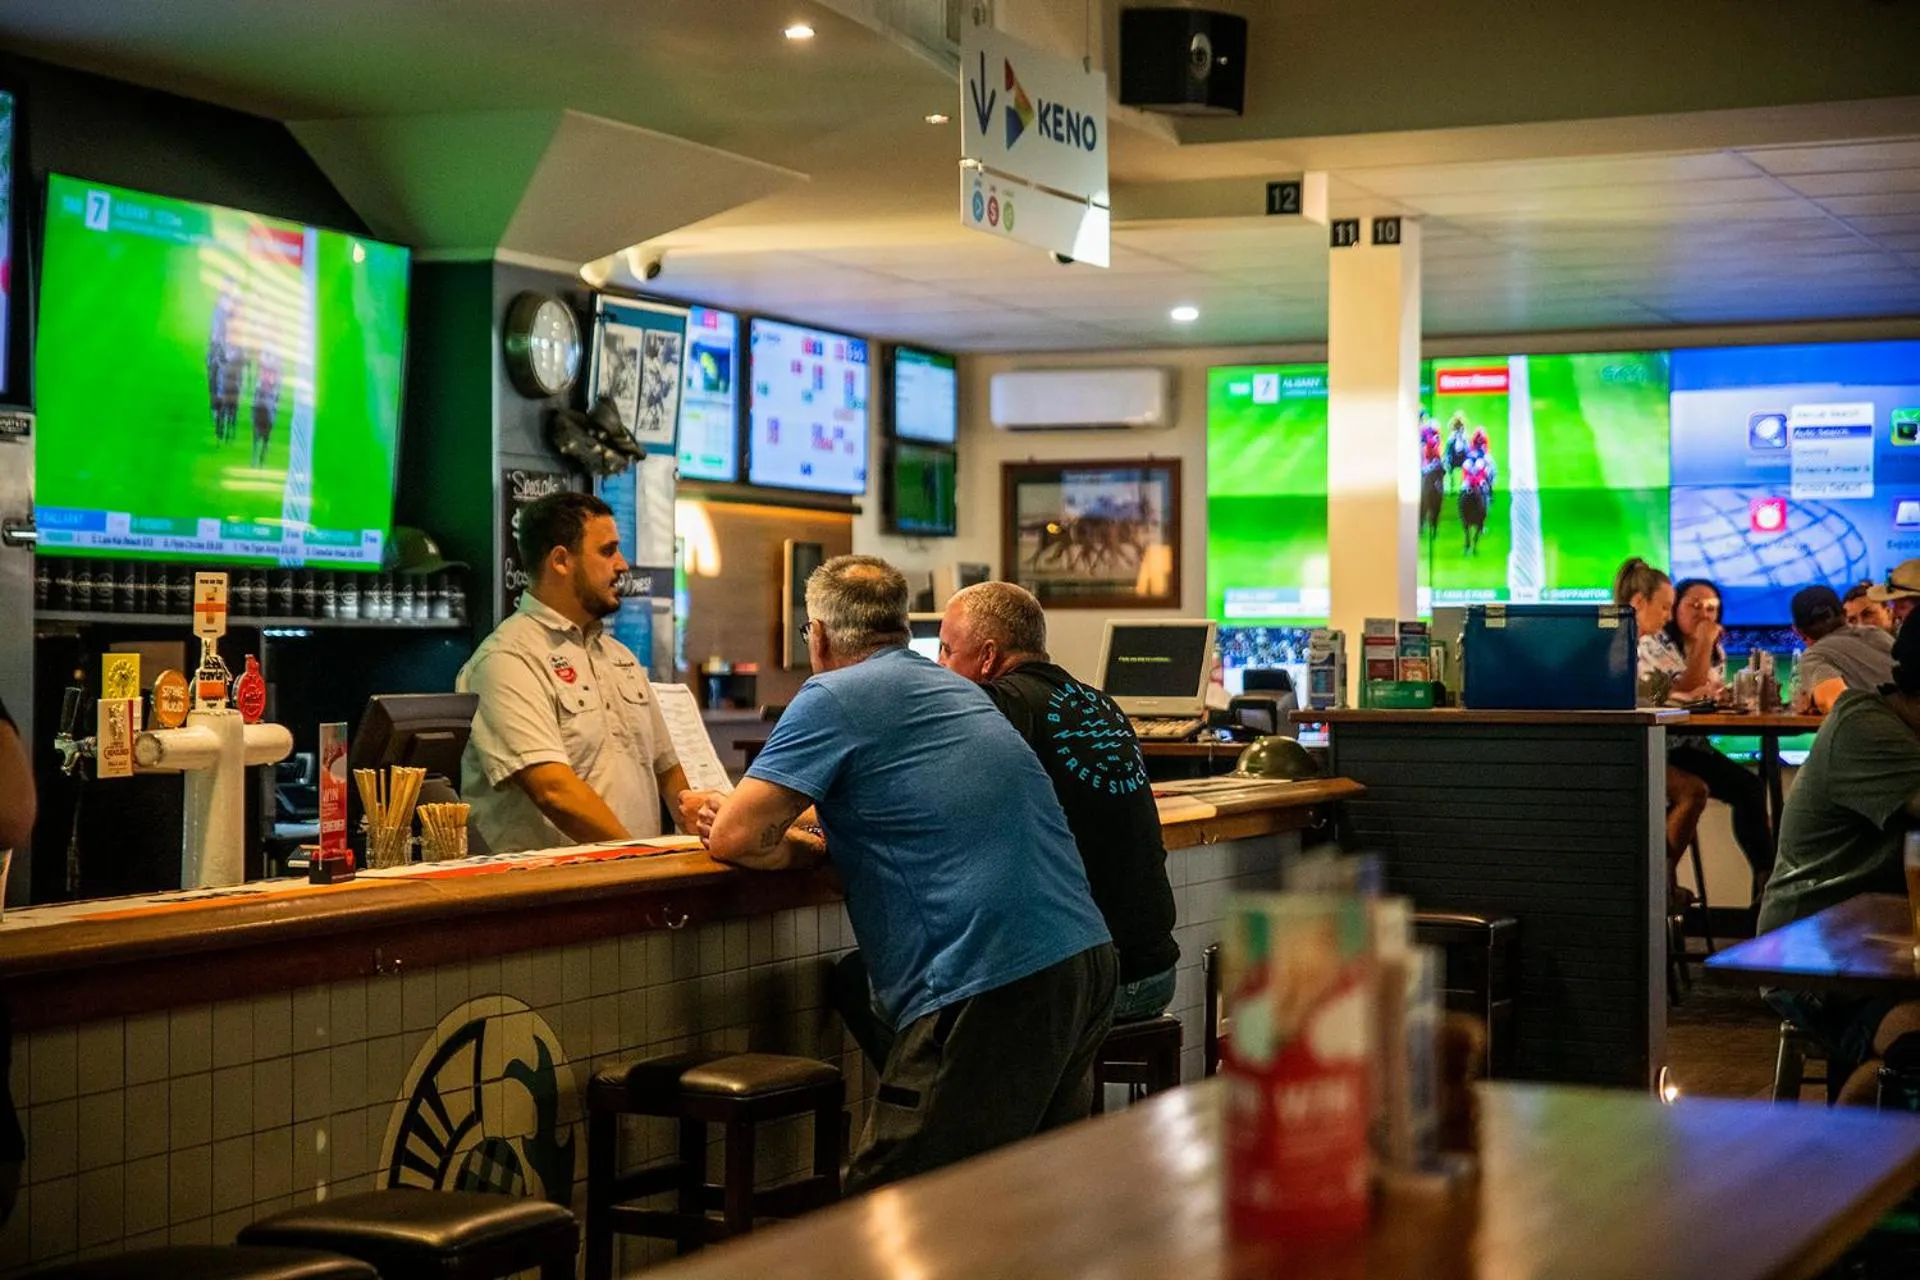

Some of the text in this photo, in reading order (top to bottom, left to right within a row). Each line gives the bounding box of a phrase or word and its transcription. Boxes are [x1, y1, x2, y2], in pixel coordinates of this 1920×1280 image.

[1037, 98, 1097, 151] KENO
[93, 197, 104, 222] 7
[1271, 185, 1297, 211] 12
[1335, 223, 1358, 244] 11
[1375, 221, 1397, 242] 10
[1056, 746, 1103, 789] FREE
